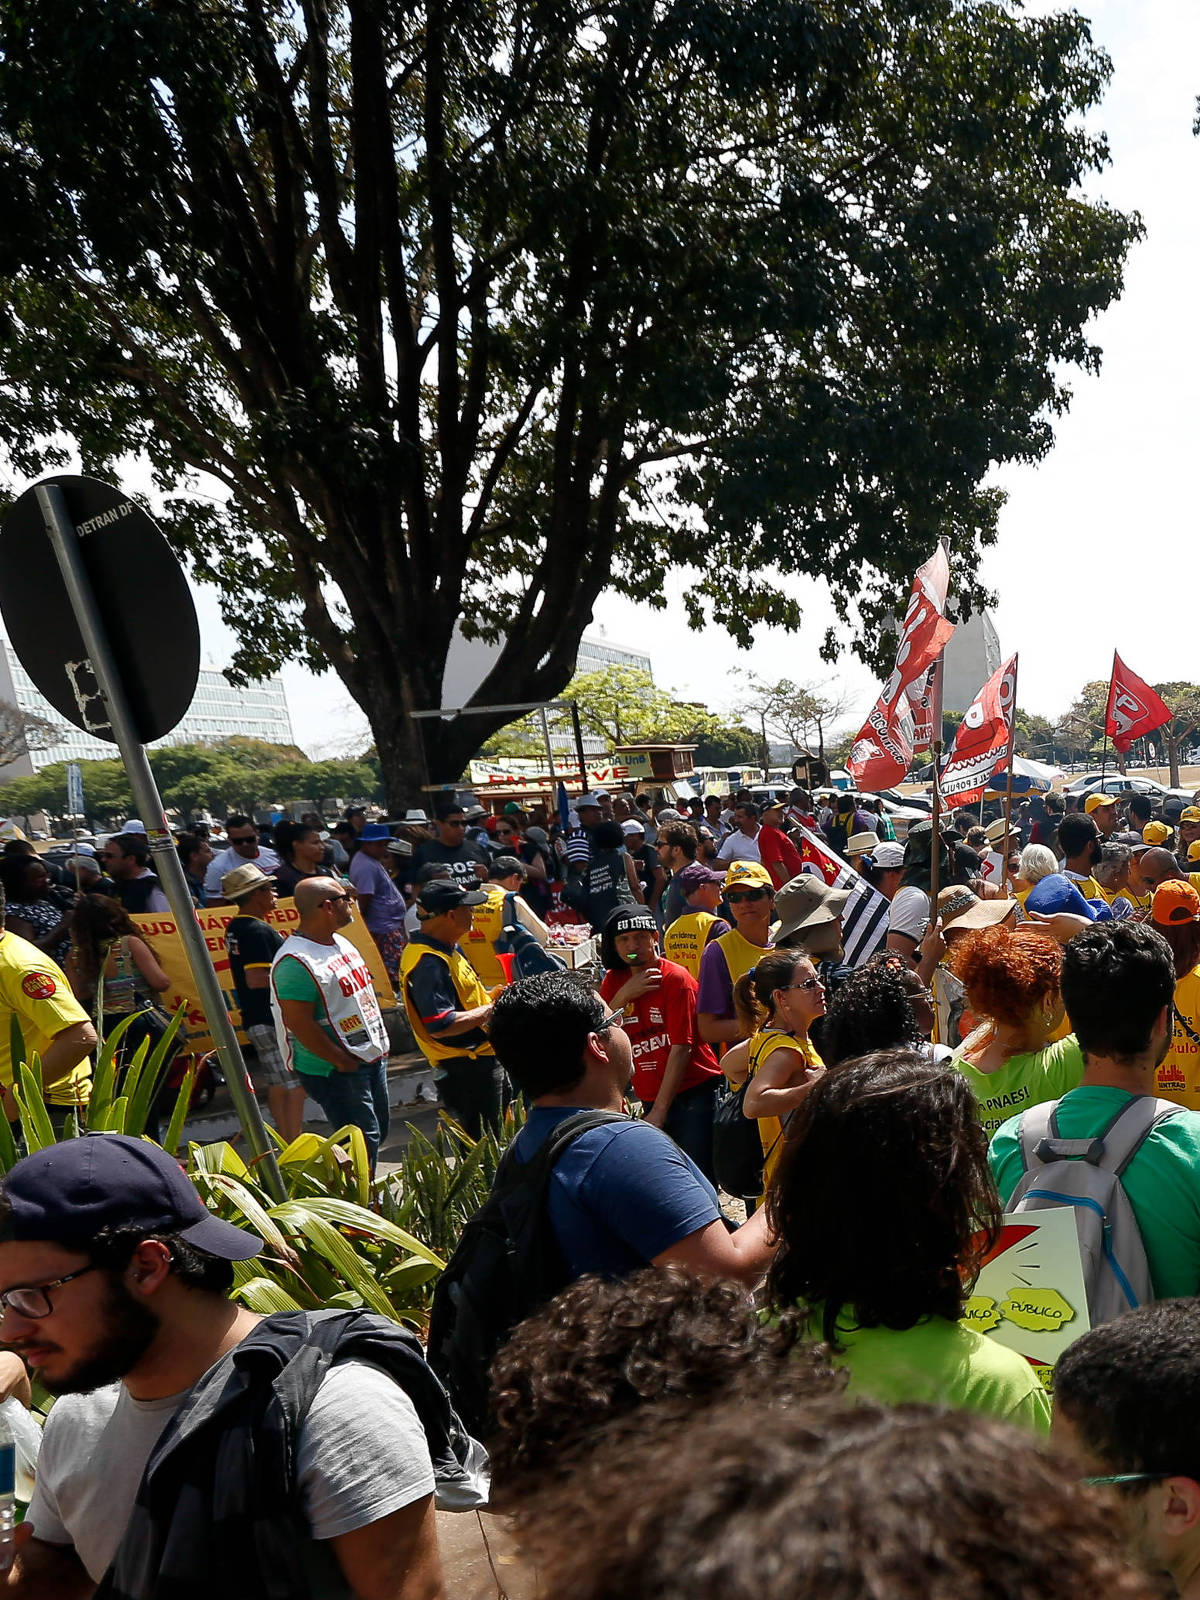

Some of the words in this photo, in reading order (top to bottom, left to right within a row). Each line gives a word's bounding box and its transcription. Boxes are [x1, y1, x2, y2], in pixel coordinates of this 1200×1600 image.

[76, 508, 119, 537] DETRAN
[118, 501, 133, 517] DF
[608, 756, 621, 766] DA
[625, 753, 646, 764] UnB
[986, 1085, 1030, 1111] PNAES!
[1010, 1300, 1063, 1319] PÚBLICO
